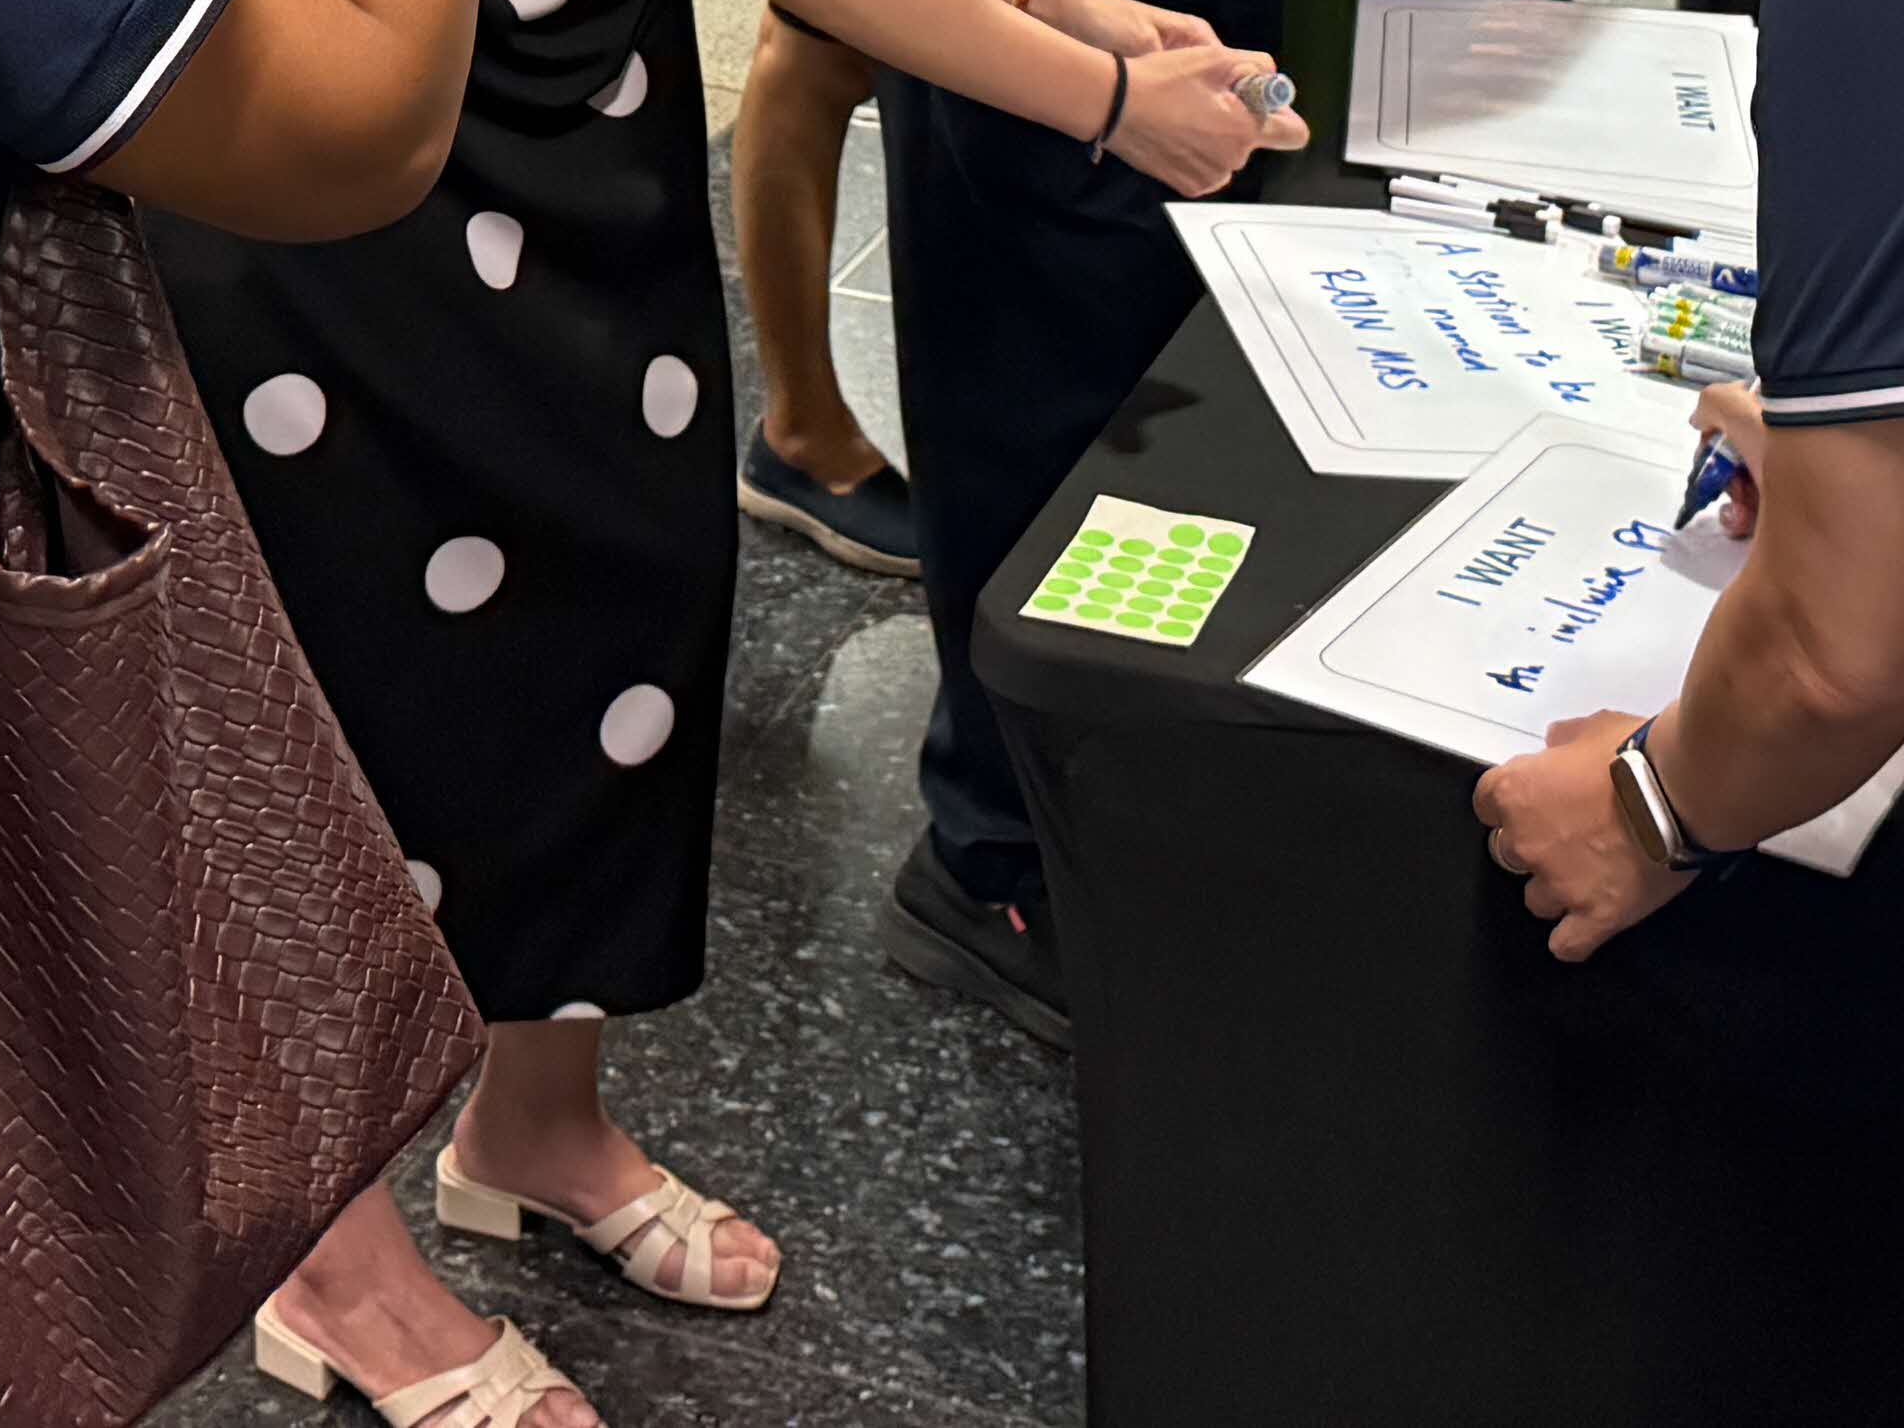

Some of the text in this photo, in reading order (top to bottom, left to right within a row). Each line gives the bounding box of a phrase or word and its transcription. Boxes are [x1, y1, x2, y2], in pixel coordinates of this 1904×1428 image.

[1674, 85, 1717, 132] WANT
[1309, 268, 1430, 391] RADIN MAS
[1448, 269, 1532, 336] Station
[1423, 307, 1498, 372] named
[1435, 516, 1557, 607] I WANT
